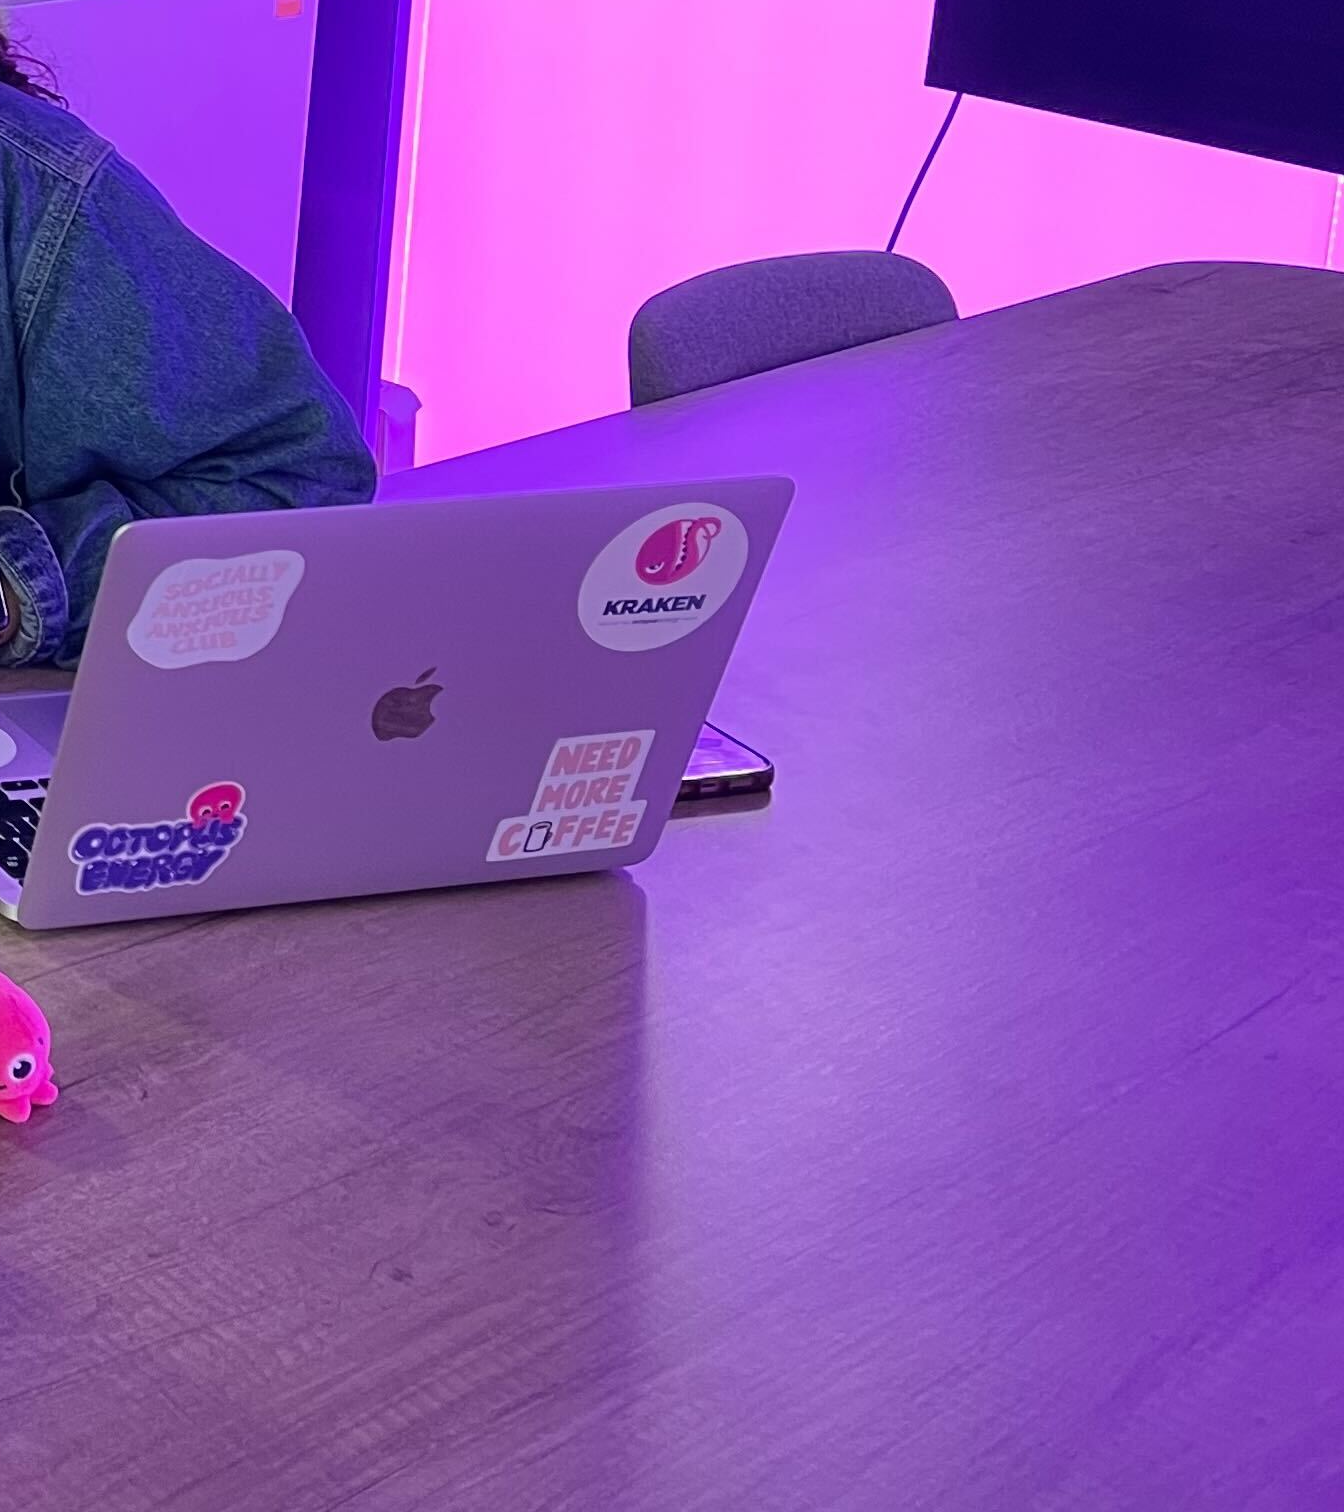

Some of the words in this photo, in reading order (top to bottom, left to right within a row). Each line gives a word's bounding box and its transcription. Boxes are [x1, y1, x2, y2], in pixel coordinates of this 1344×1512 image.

[602, 594, 706, 615] KRAKEN
[170, 631, 237, 654] CLUB
[550, 736, 642, 777] NEED
[536, 774, 631, 812] MORE
[73, 817, 243, 859] OCTOPUS
[498, 809, 637, 856] CFFEE
[80, 849, 224, 891] ENERGY
